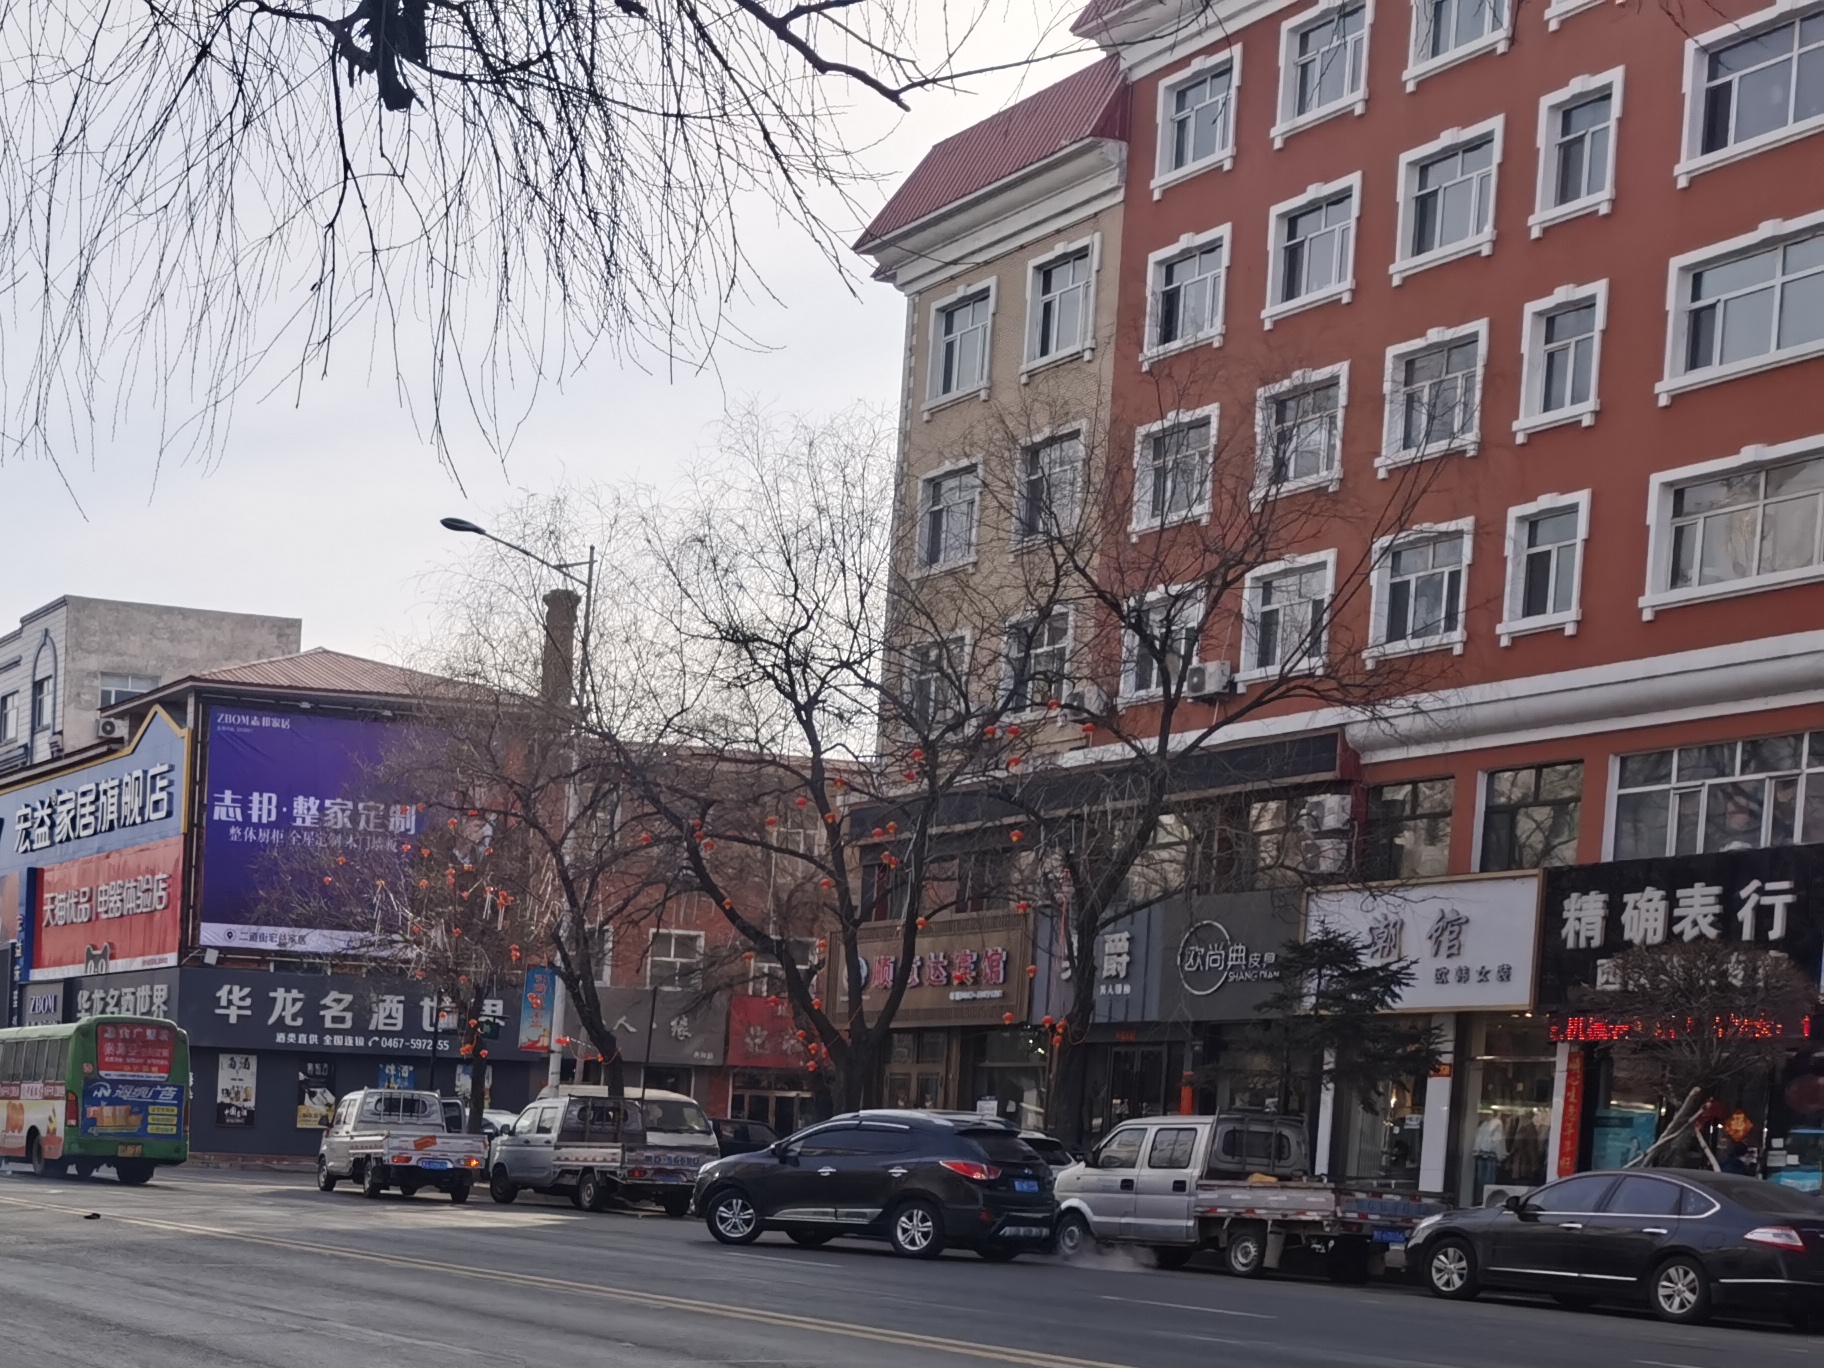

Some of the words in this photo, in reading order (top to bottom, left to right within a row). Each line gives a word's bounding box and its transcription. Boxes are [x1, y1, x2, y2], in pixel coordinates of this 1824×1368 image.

[42, 885, 93, 928] 天猫优品
[96, 872, 171, 921] 电器体验店
[1560, 878, 1798, 950] 精确表行
[29, 994, 58, 1014] ZBOM
[275, 1032, 320, 1046] 酒类直供
[380, 1037, 451, 1052] 0467-597255
